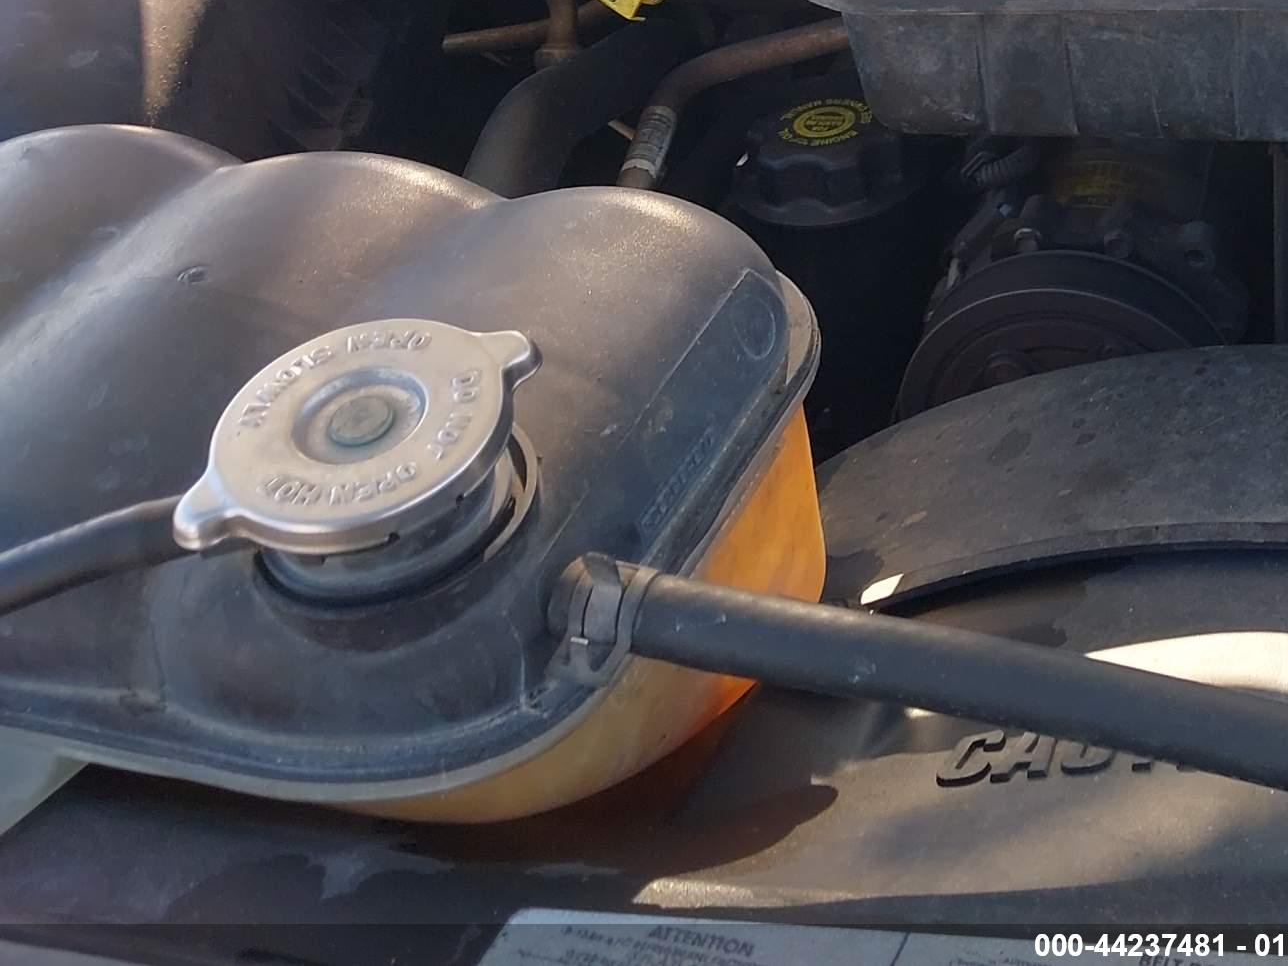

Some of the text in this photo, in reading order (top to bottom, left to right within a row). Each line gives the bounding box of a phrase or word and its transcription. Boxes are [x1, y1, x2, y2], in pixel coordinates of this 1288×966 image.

[239, 330, 432, 429] OPEN SLOWLY
[256, 367, 483, 508] DO NOT OPEN HOT
[648, 924, 756, 958] ATTENTION
